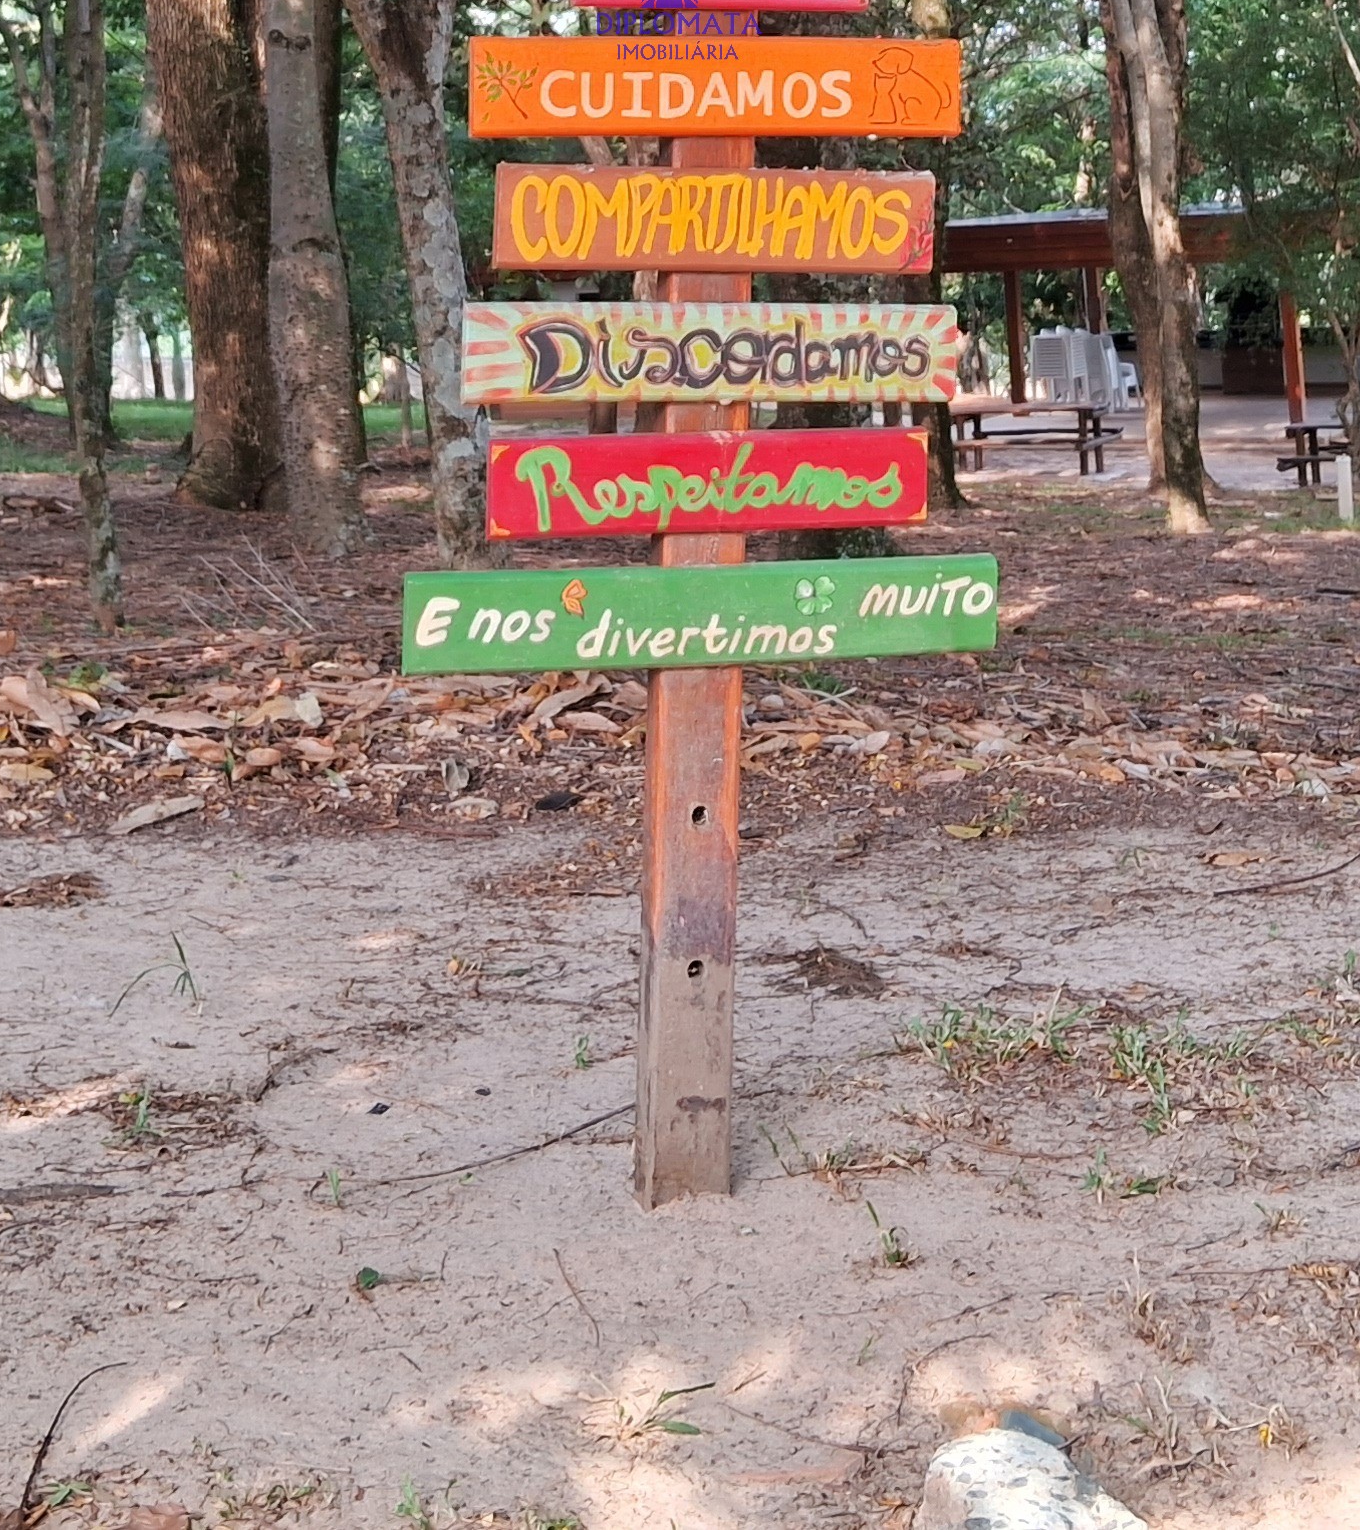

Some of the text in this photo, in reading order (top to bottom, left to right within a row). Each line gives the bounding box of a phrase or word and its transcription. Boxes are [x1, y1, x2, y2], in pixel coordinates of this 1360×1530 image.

[540, 70, 853, 118] CUIDAMOS
[511, 173, 911, 261] COMPARTILHAMOS
[521, 315, 930, 394] Discordamos
[515, 441, 901, 532] Respeitamos
[415, 596, 462, 646] E
[468, 607, 557, 643] nos
[576, 608, 838, 659] divertimos
